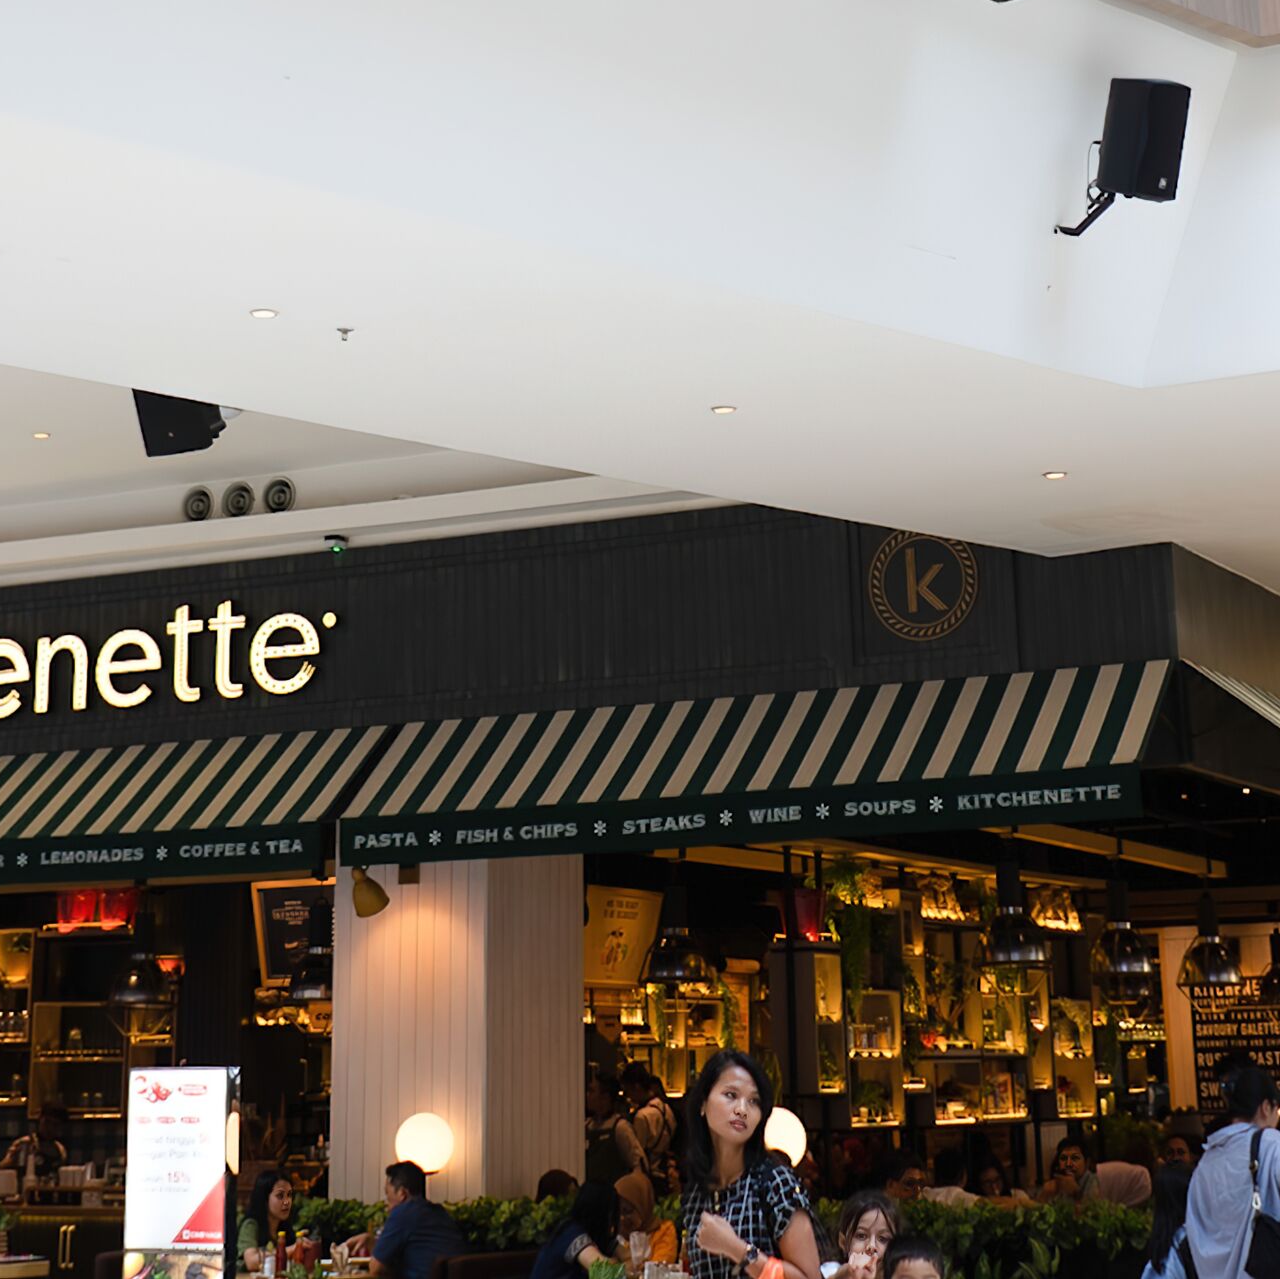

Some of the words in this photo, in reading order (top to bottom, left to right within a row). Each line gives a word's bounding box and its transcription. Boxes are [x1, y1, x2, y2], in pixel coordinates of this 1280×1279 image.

[353, 831, 418, 850] PASTA
[455, 827, 499, 845] FISH
[502, 826, 515, 842] &
[519, 822, 578, 841] CHIPS
[621, 813, 706, 835] STEAKS
[749, 806, 802, 825] WINE
[843, 798, 917, 819] SOUPS
[956, 784, 1121, 812] KITCHENETTE
[40, 847, 144, 866] LEMONADES
[179, 841, 247, 859] COFFEE
[265, 839, 303, 855] TEA
